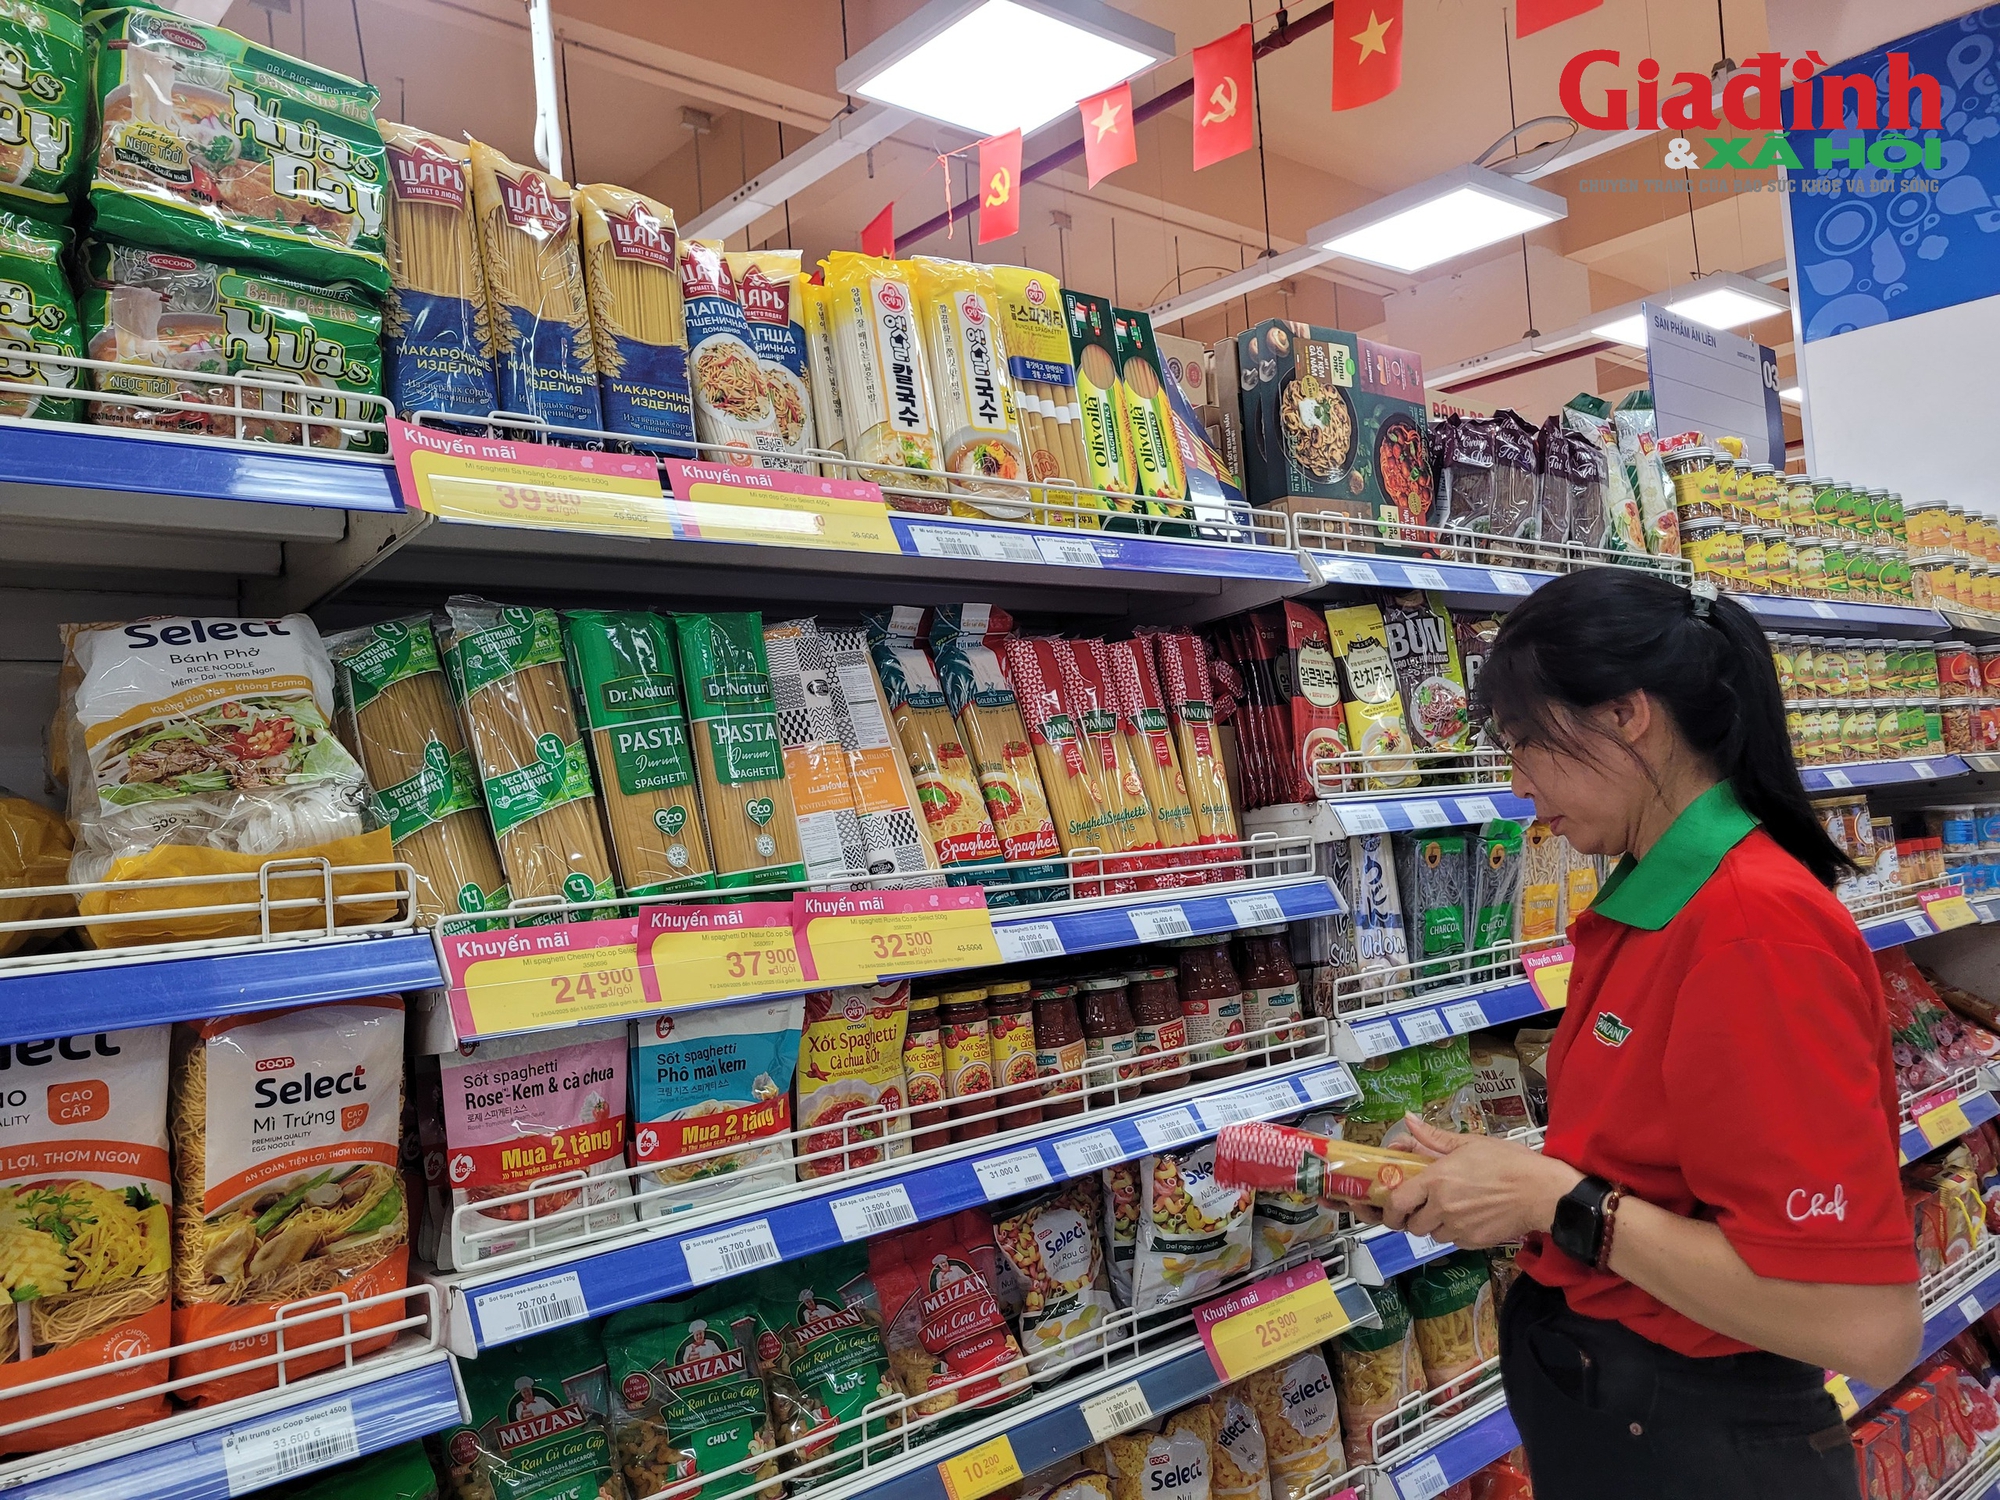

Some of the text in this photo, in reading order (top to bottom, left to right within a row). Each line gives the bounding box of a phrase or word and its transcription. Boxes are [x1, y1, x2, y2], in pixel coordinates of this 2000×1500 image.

[266, 63, 311, 86] DRY RICE
[125, 136, 183, 164] NGỌC TRỜI
[399, 159, 464, 192] ЦАРЬ
[616, 223, 671, 253] ЦАРЬ
[148, 254, 194, 269] ACECOOK
[685, 301, 745, 321] ЛАПША
[687, 317, 748, 331] ПШЕНИЧНАЯ
[1670, 321, 1690, 339] PHẨM
[1691, 332, 1701, 342] ĂN
[1701, 330, 1717, 348] LIỀN
[1763, 360, 1780, 391] 03
[631, 397, 689, 414] ИЗДЕЛИЯ
[404, 427, 517, 459] Khuyến mãi
[1085, 396, 1107, 467] Olivoilà
[1130, 406, 1156, 472] Olivoilà
[682, 465, 772, 487] Khuyến mãi
[495, 485, 541, 511] 39
[124, 619, 290, 649] Select
[170, 648, 260, 664] Bánh Phở
[187, 662, 254, 674] RICE NOODLE
[252, 667, 275, 676] Ngon
[235, 682, 268, 691] Không
[271, 680, 306, 688] Formol
[1182, 705, 1213, 719] PANZANI
[618, 726, 684, 753] PASTA
[717, 723, 777, 745] PASTA
[636, 755, 681, 774] Durum
[730, 747, 770, 765] Durum
[635, 773, 688, 789] SPAGHETTI
[660, 812, 683, 824] eco
[752, 802, 771, 814] eco
[806, 897, 884, 916] Khuyến mãi
[651, 909, 743, 930] Khuyến mãi
[457, 932, 569, 958] Khuyến mãi
[871, 931, 932, 959] 32 500
[1361, 930, 1404, 959] Udon
[726, 949, 796, 978] 37 900
[1527, 952, 1563, 967] Khuyến mãi
[552, 967, 633, 1004] 24 900
[809, 1024, 897, 1053] Xốt Spaghetti
[847, 1022, 867, 1031] OTTOGI
[1161, 1027, 1184, 1041] THỊT
[1596, 1017, 1623, 1042] PANZANI
[257, 1058, 293, 1071] COOP
[657, 1043, 737, 1065] Sốt spaghetti
[830, 1053, 865, 1071] Cà chua
[464, 1060, 558, 1089] Sốt spaghetti
[548, 1067, 614, 1093] & cà chua
[657, 1058, 746, 1083] Phô mai kem
[1482, 1070, 1498, 1080] NUI
[60, 1088, 94, 1103] CAO
[254, 1065, 366, 1108] Select
[60, 1103, 91, 1119] CẤP
[253, 1109, 335, 1134] Mì Trứng
[347, 1110, 364, 1119] CAO
[683, 1099, 785, 1146] Mua 2 tặng 1
[252, 1130, 312, 1146] PREMIUM QUALITY
[252, 1140, 295, 1153] EGG NOODLE
[502, 1120, 623, 1171] Mua 2 tặng 1
[1080, 1144, 1096, 1154] 63.700
[7, 1150, 140, 1171] LỢI, THƠM NGON
[245, 1146, 374, 1184] AN TOÀN, TIỆN LỢI, THƠM NGON
[989, 1165, 1012, 1179] 31.000
[862, 1204, 884, 1214] 13.500
[1786, 1184, 1848, 1222] Chef
[718, 1242, 744, 1254] 35.700
[1045, 1221, 1087, 1258] Select
[499, 1292, 513, 1300] Spag
[549, 1279, 562, 1287] chua
[923, 1274, 988, 1314] MEIZAN
[517, 1296, 547, 1310] 20.700
[1202, 1298, 1239, 1322] Khuyến
[1240, 1290, 1259, 1307] mãi
[795, 1308, 861, 1343] MEIZAN
[925, 1306, 976, 1344] Nui Cao
[1256, 1311, 1297, 1347] 25 900
[228, 1335, 256, 1353] 450
[795, 1333, 866, 1376] Nui Rau Củ Cao
[957, 1337, 994, 1360] HÌNH SAO
[668, 1352, 745, 1390] MEIZAN
[667, 1383, 760, 1420] Nui Rau Củ Cao Cấp
[1282, 1374, 1331, 1409] Select
[1303, 1404, 1318, 1417] Nui
[238, 1435, 247, 1443] Mi
[249, 1429, 270, 1439] trung
[283, 1419, 303, 1429] Coop
[305, 1411, 328, 1422] Select
[329, 1405, 347, 1415] 450g
[499, 1406, 587, 1450] MEIZAN
[273, 1431, 310, 1450] 33.600
[520, 1434, 605, 1474] Rau Củ Cao Cấp
[962, 1454, 1000, 1485] 10 200
[1151, 1458, 1202, 1492] Select
